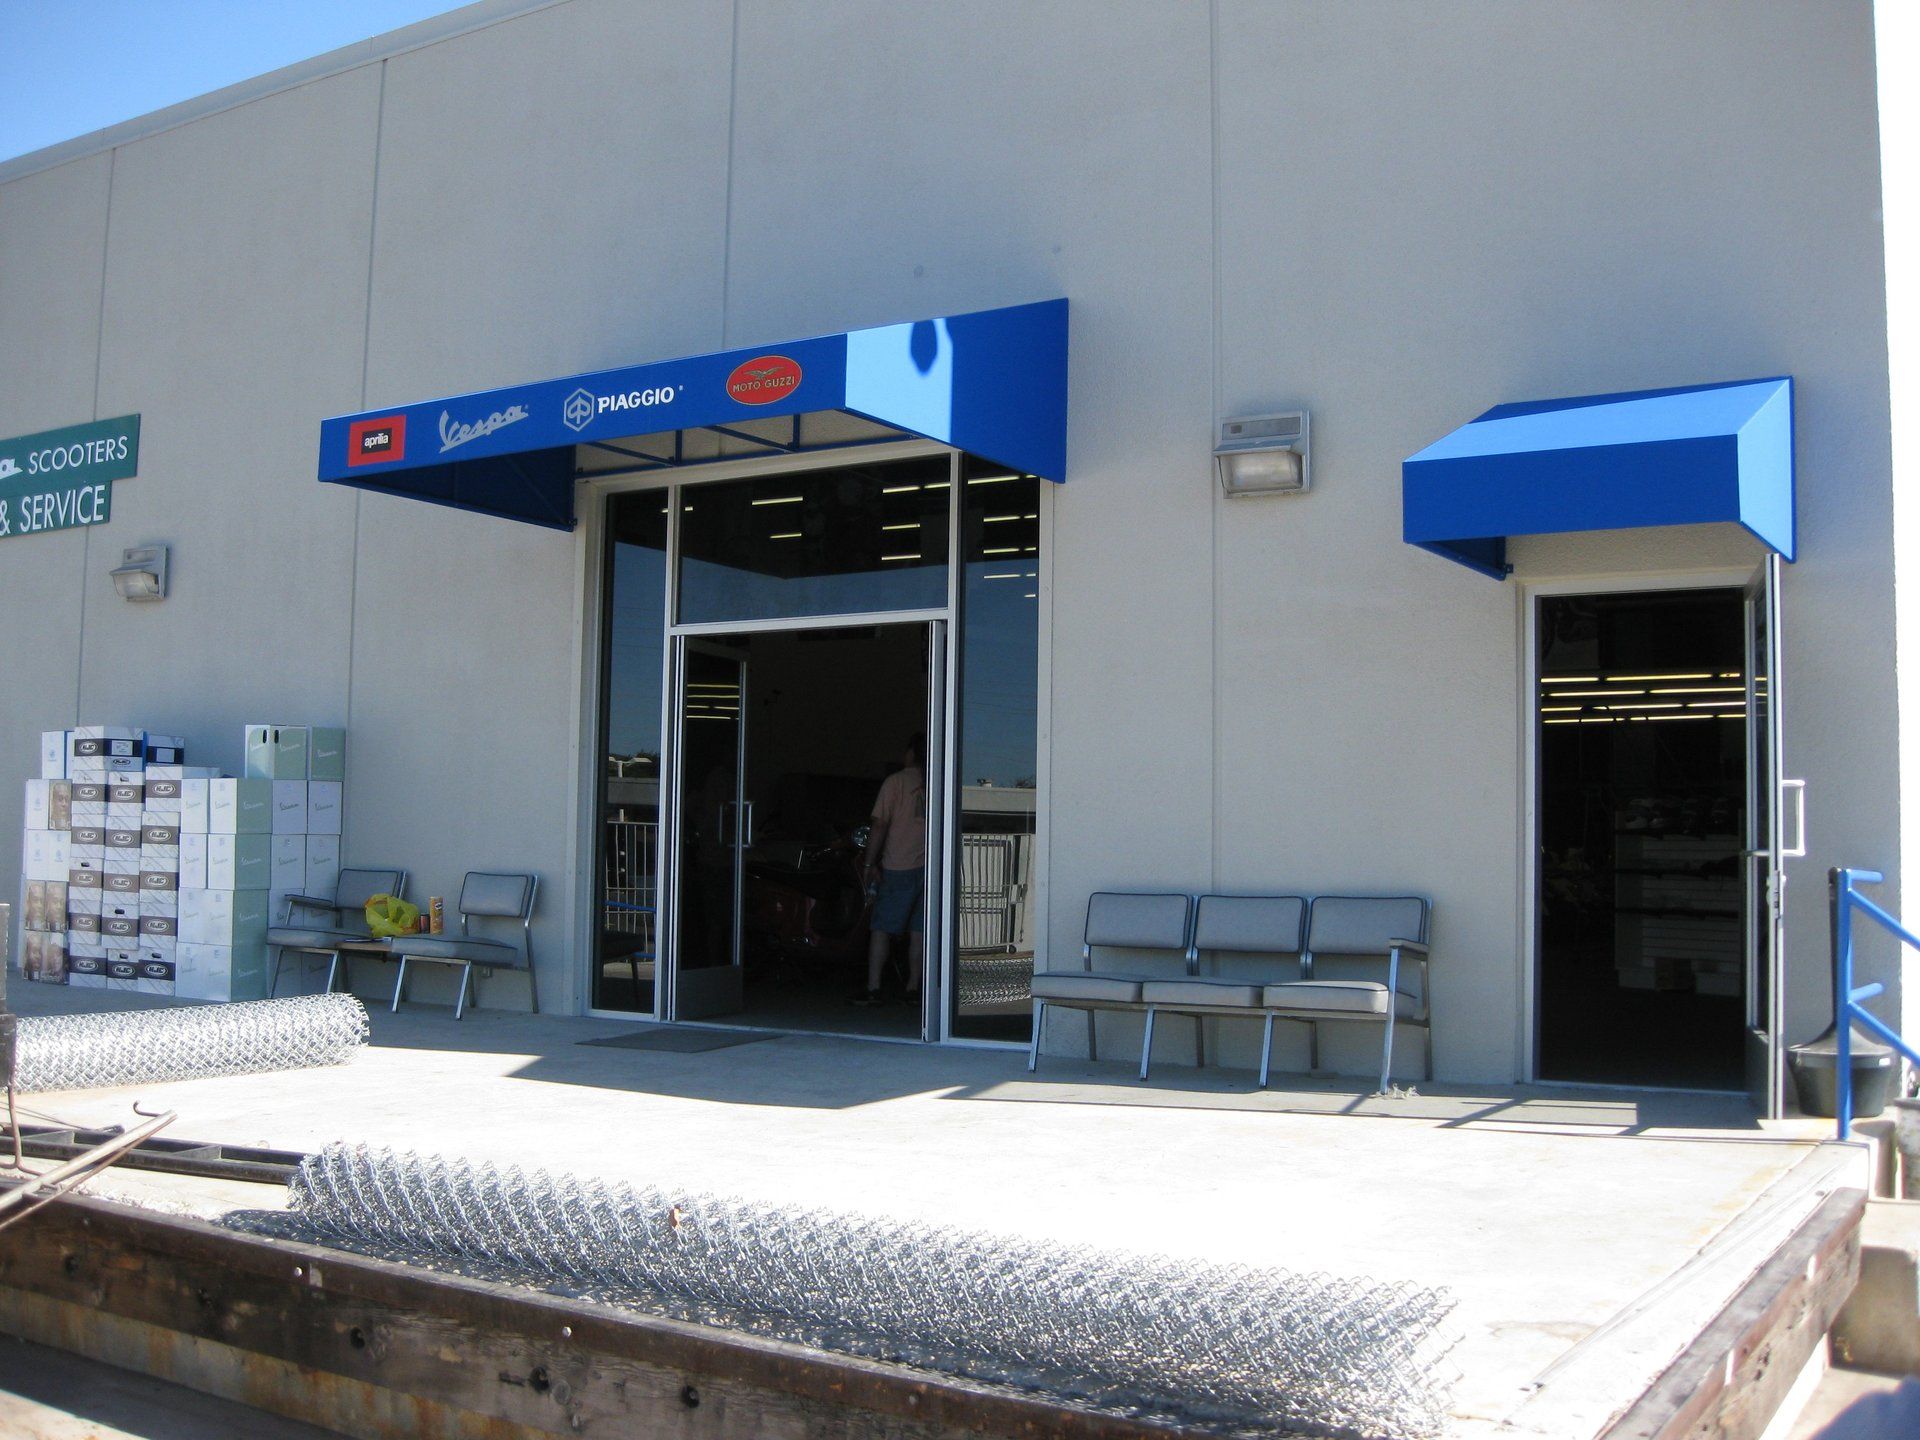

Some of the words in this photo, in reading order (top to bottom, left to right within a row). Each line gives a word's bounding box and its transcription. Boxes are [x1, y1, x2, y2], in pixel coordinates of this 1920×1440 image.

[597, 386, 675, 414] PIAGGIO
[732, 381, 761, 393] MOTO
[764, 376, 795, 389] GUZZI
[364, 432, 389, 449] aprilia
[439, 409, 528, 454] Vespa
[28, 435, 128, 475] SCOOTERS
[20, 484, 105, 532] SERVICE
